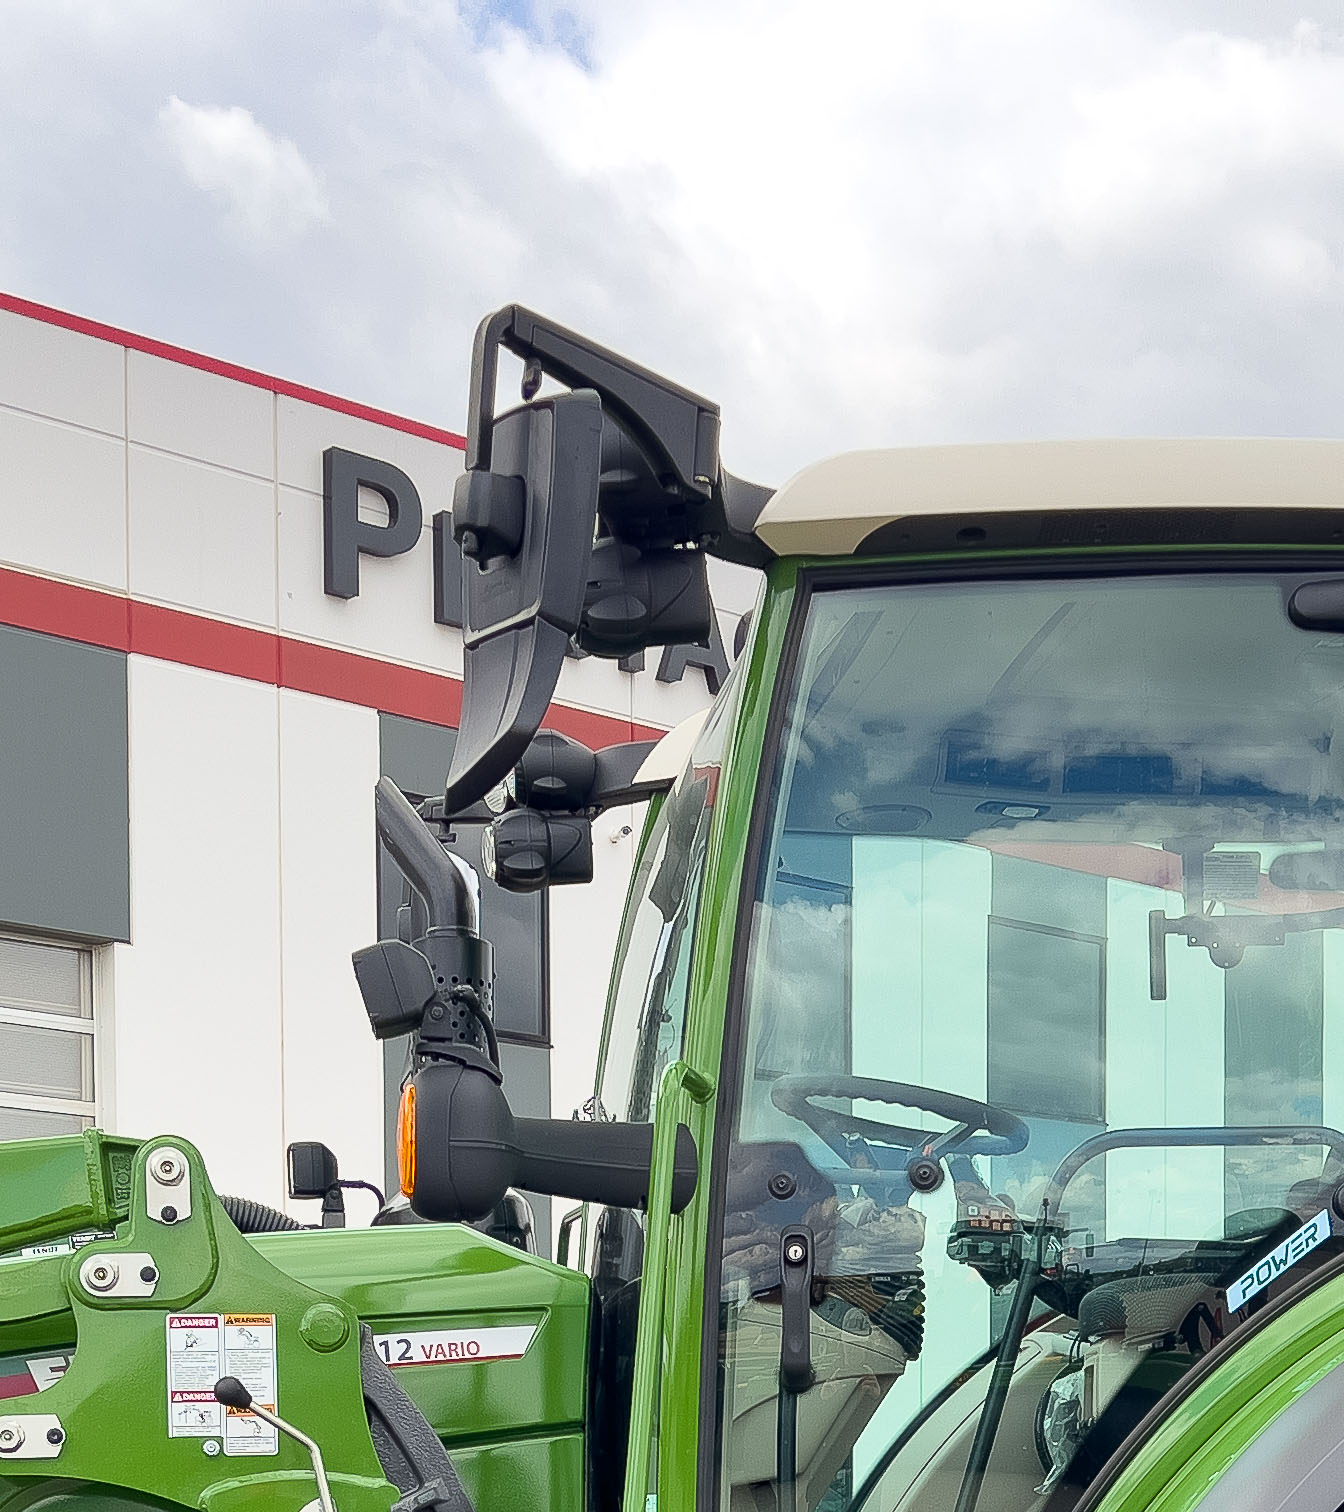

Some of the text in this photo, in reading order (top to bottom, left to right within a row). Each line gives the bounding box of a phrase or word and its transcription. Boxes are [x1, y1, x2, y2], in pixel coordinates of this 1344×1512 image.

[1239, 1222, 1319, 1300] POWER
[180, 1318, 216, 1328] DANGER
[420, 1340, 481, 1360] VARIO
